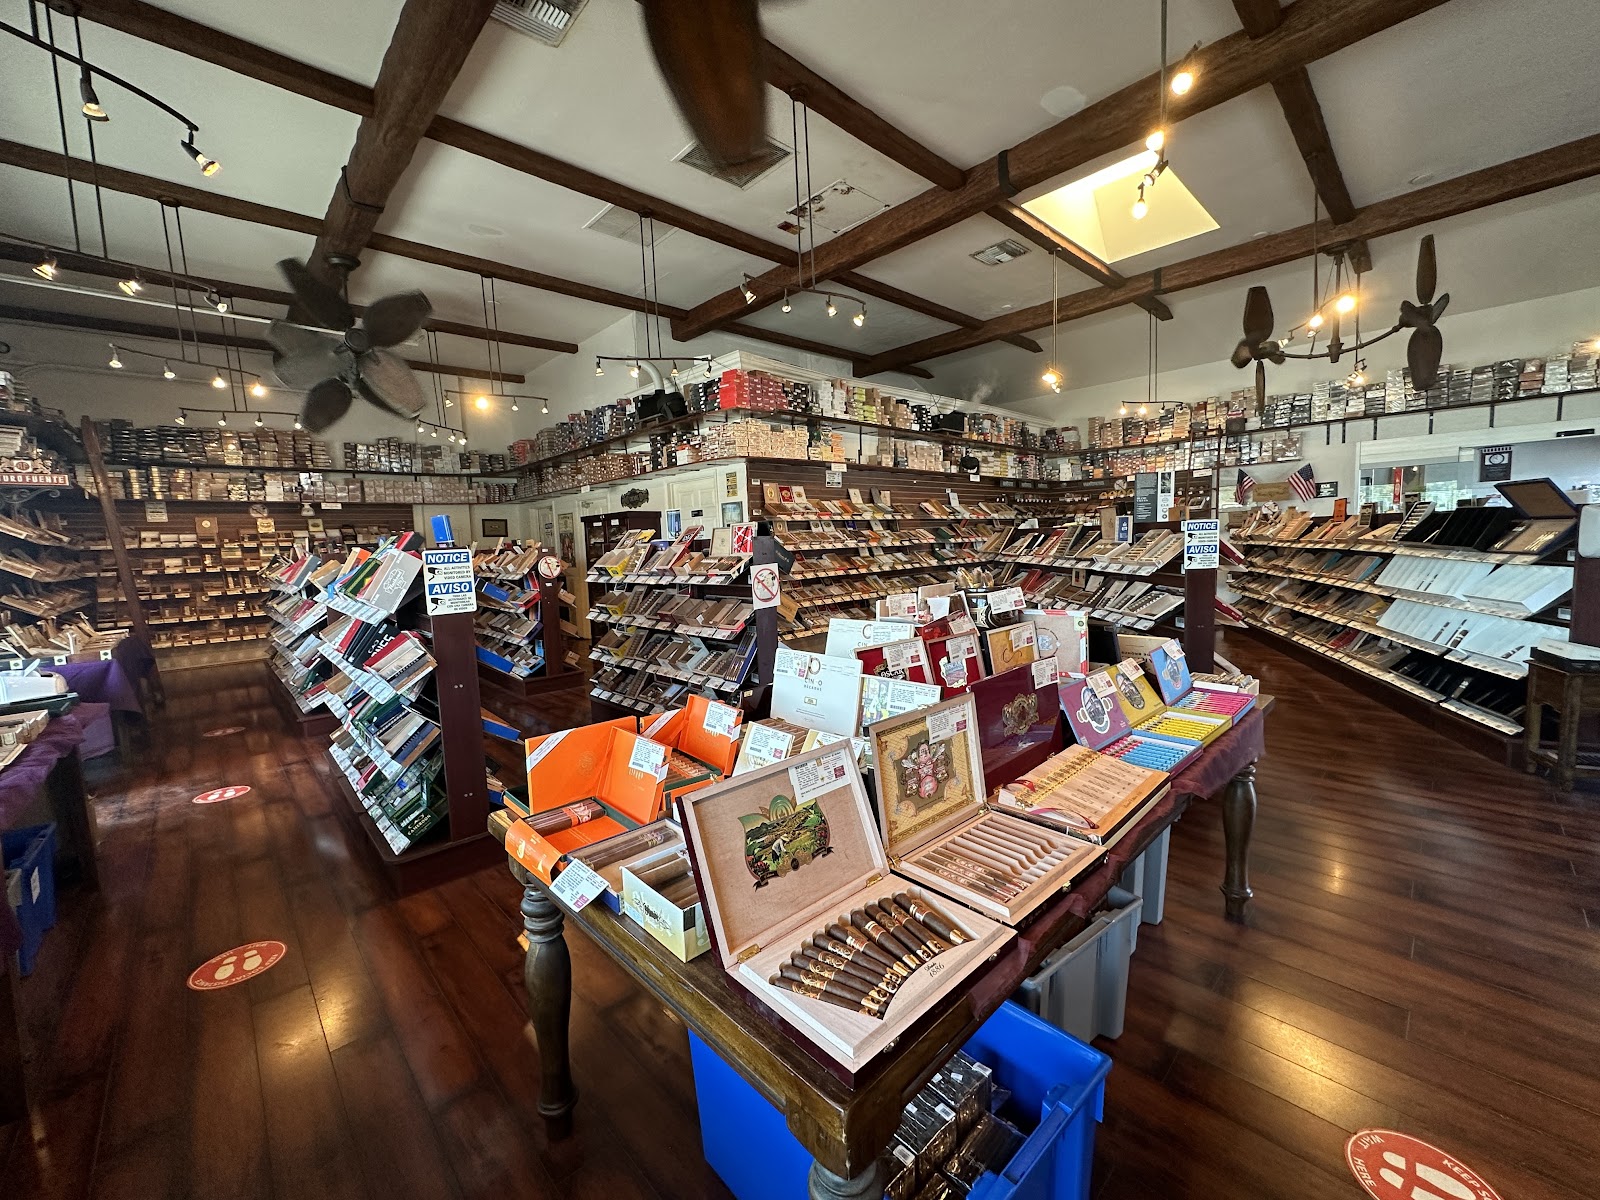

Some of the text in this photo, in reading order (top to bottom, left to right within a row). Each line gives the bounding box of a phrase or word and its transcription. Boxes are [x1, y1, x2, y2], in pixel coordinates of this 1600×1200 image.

[25, 475, 65, 483] FUENTE
[1188, 523, 1217, 531] NOTICE
[1189, 545, 1216, 554] AVISO
[427, 553, 468, 563] NOTICE
[432, 582, 469, 595] AVISO
[407, 814, 431, 836] CAMEROON
[929, 962, 945, 977] 1886
[1353, 1134, 1386, 1187] WAIT HERE
[1442, 1158, 1481, 1188] KEEP
